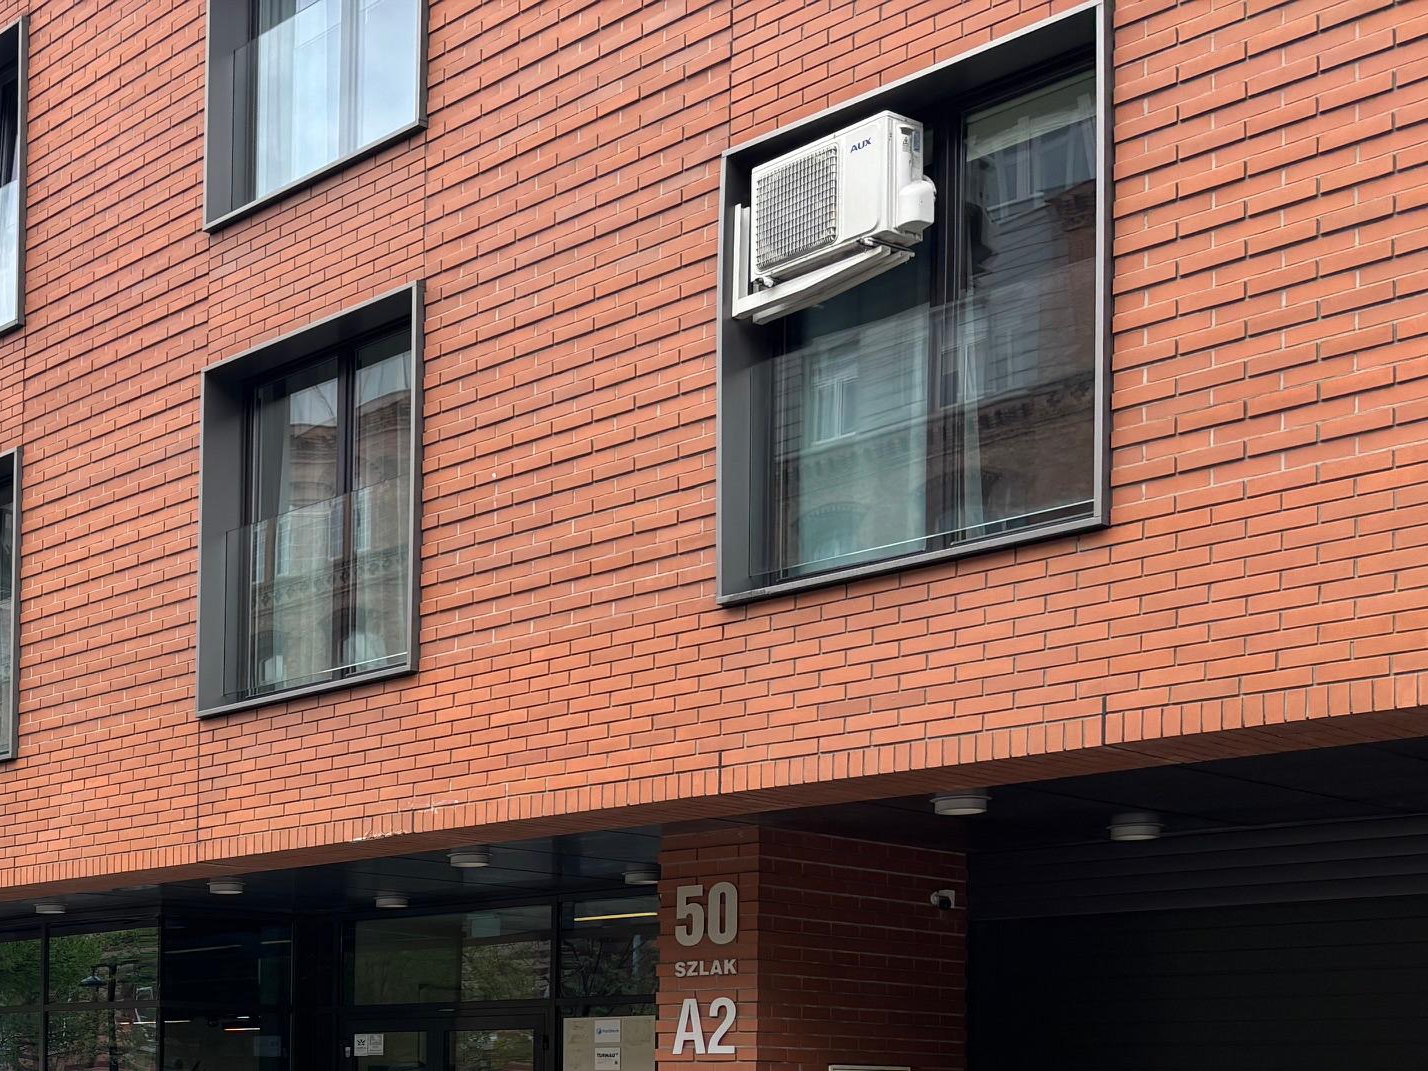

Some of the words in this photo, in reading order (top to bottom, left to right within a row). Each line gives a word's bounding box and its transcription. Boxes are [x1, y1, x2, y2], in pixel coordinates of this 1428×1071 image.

[850, 137, 872, 153] AUX
[674, 881, 738, 947] 50
[674, 958, 738, 978] SZLAK
[672, 996, 737, 1055] A2
